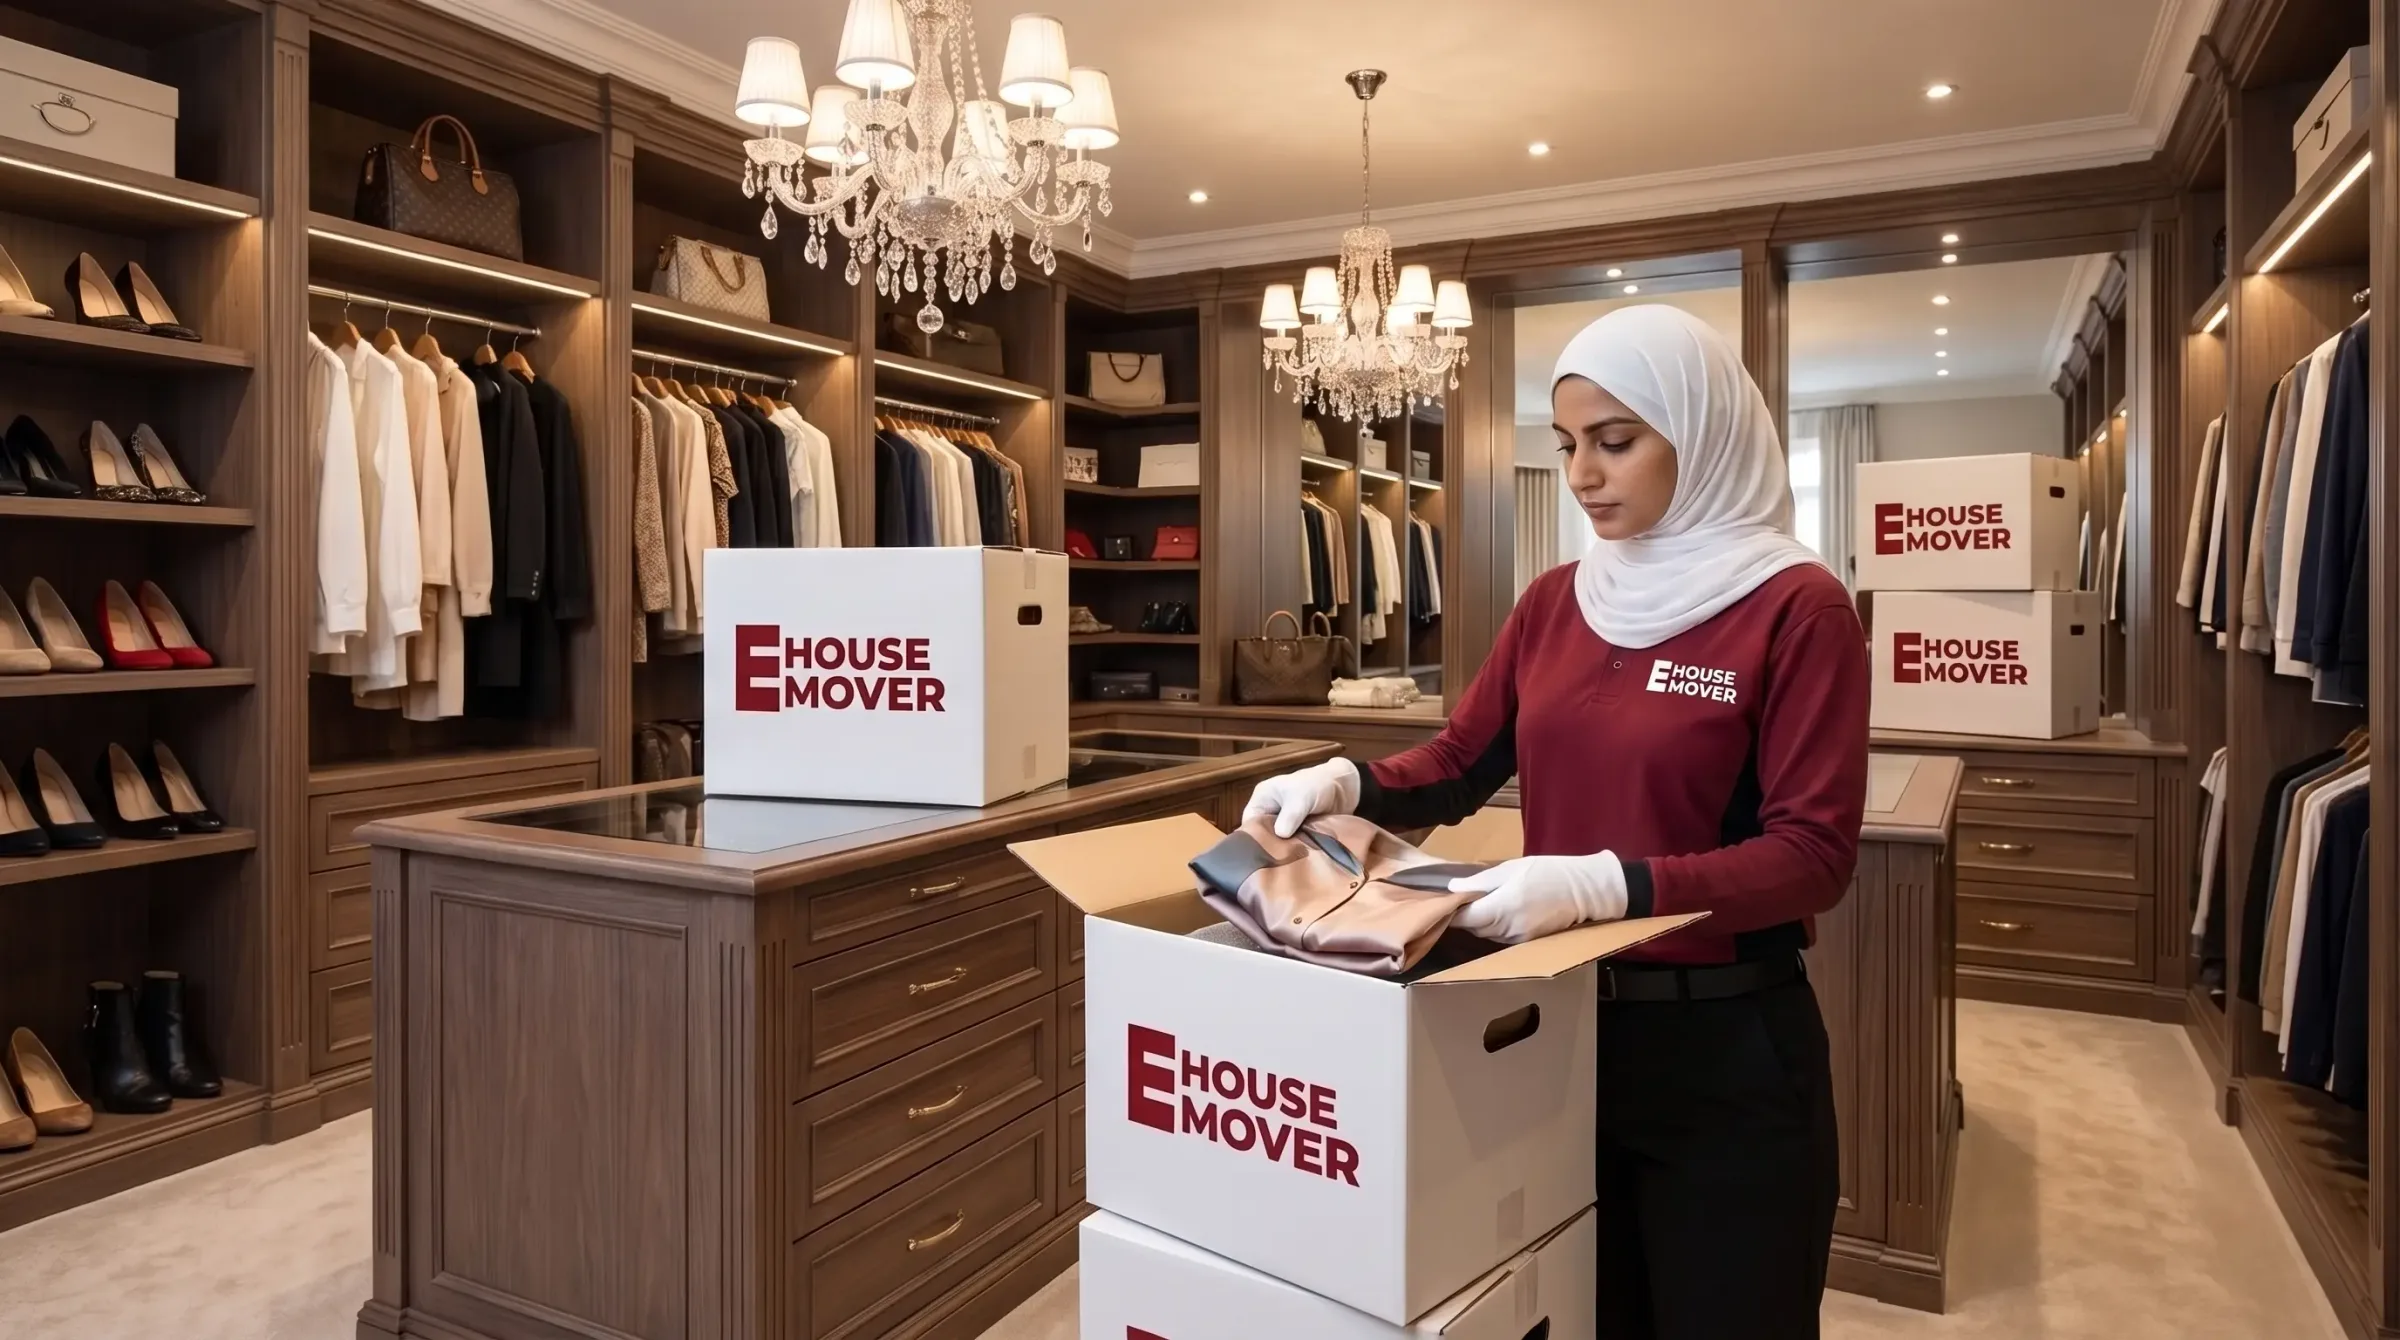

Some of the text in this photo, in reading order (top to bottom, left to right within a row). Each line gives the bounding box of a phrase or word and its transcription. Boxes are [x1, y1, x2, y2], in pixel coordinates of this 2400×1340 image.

[1906, 503, 2003, 527] HOUSE
[1906, 528, 2011, 551] MOVER
[785, 637, 930, 671] HOUSE
[1924, 639, 2019, 660] HOUSE
[1672, 664, 1736, 686] HOUSE
[1924, 662, 2028, 685] MOVER
[785, 676, 945, 712] MOVER
[1667, 680, 1737, 704] MOVER
[1182, 1050, 1337, 1130] HOUSE
[1182, 1095, 1360, 1187] MOVER
